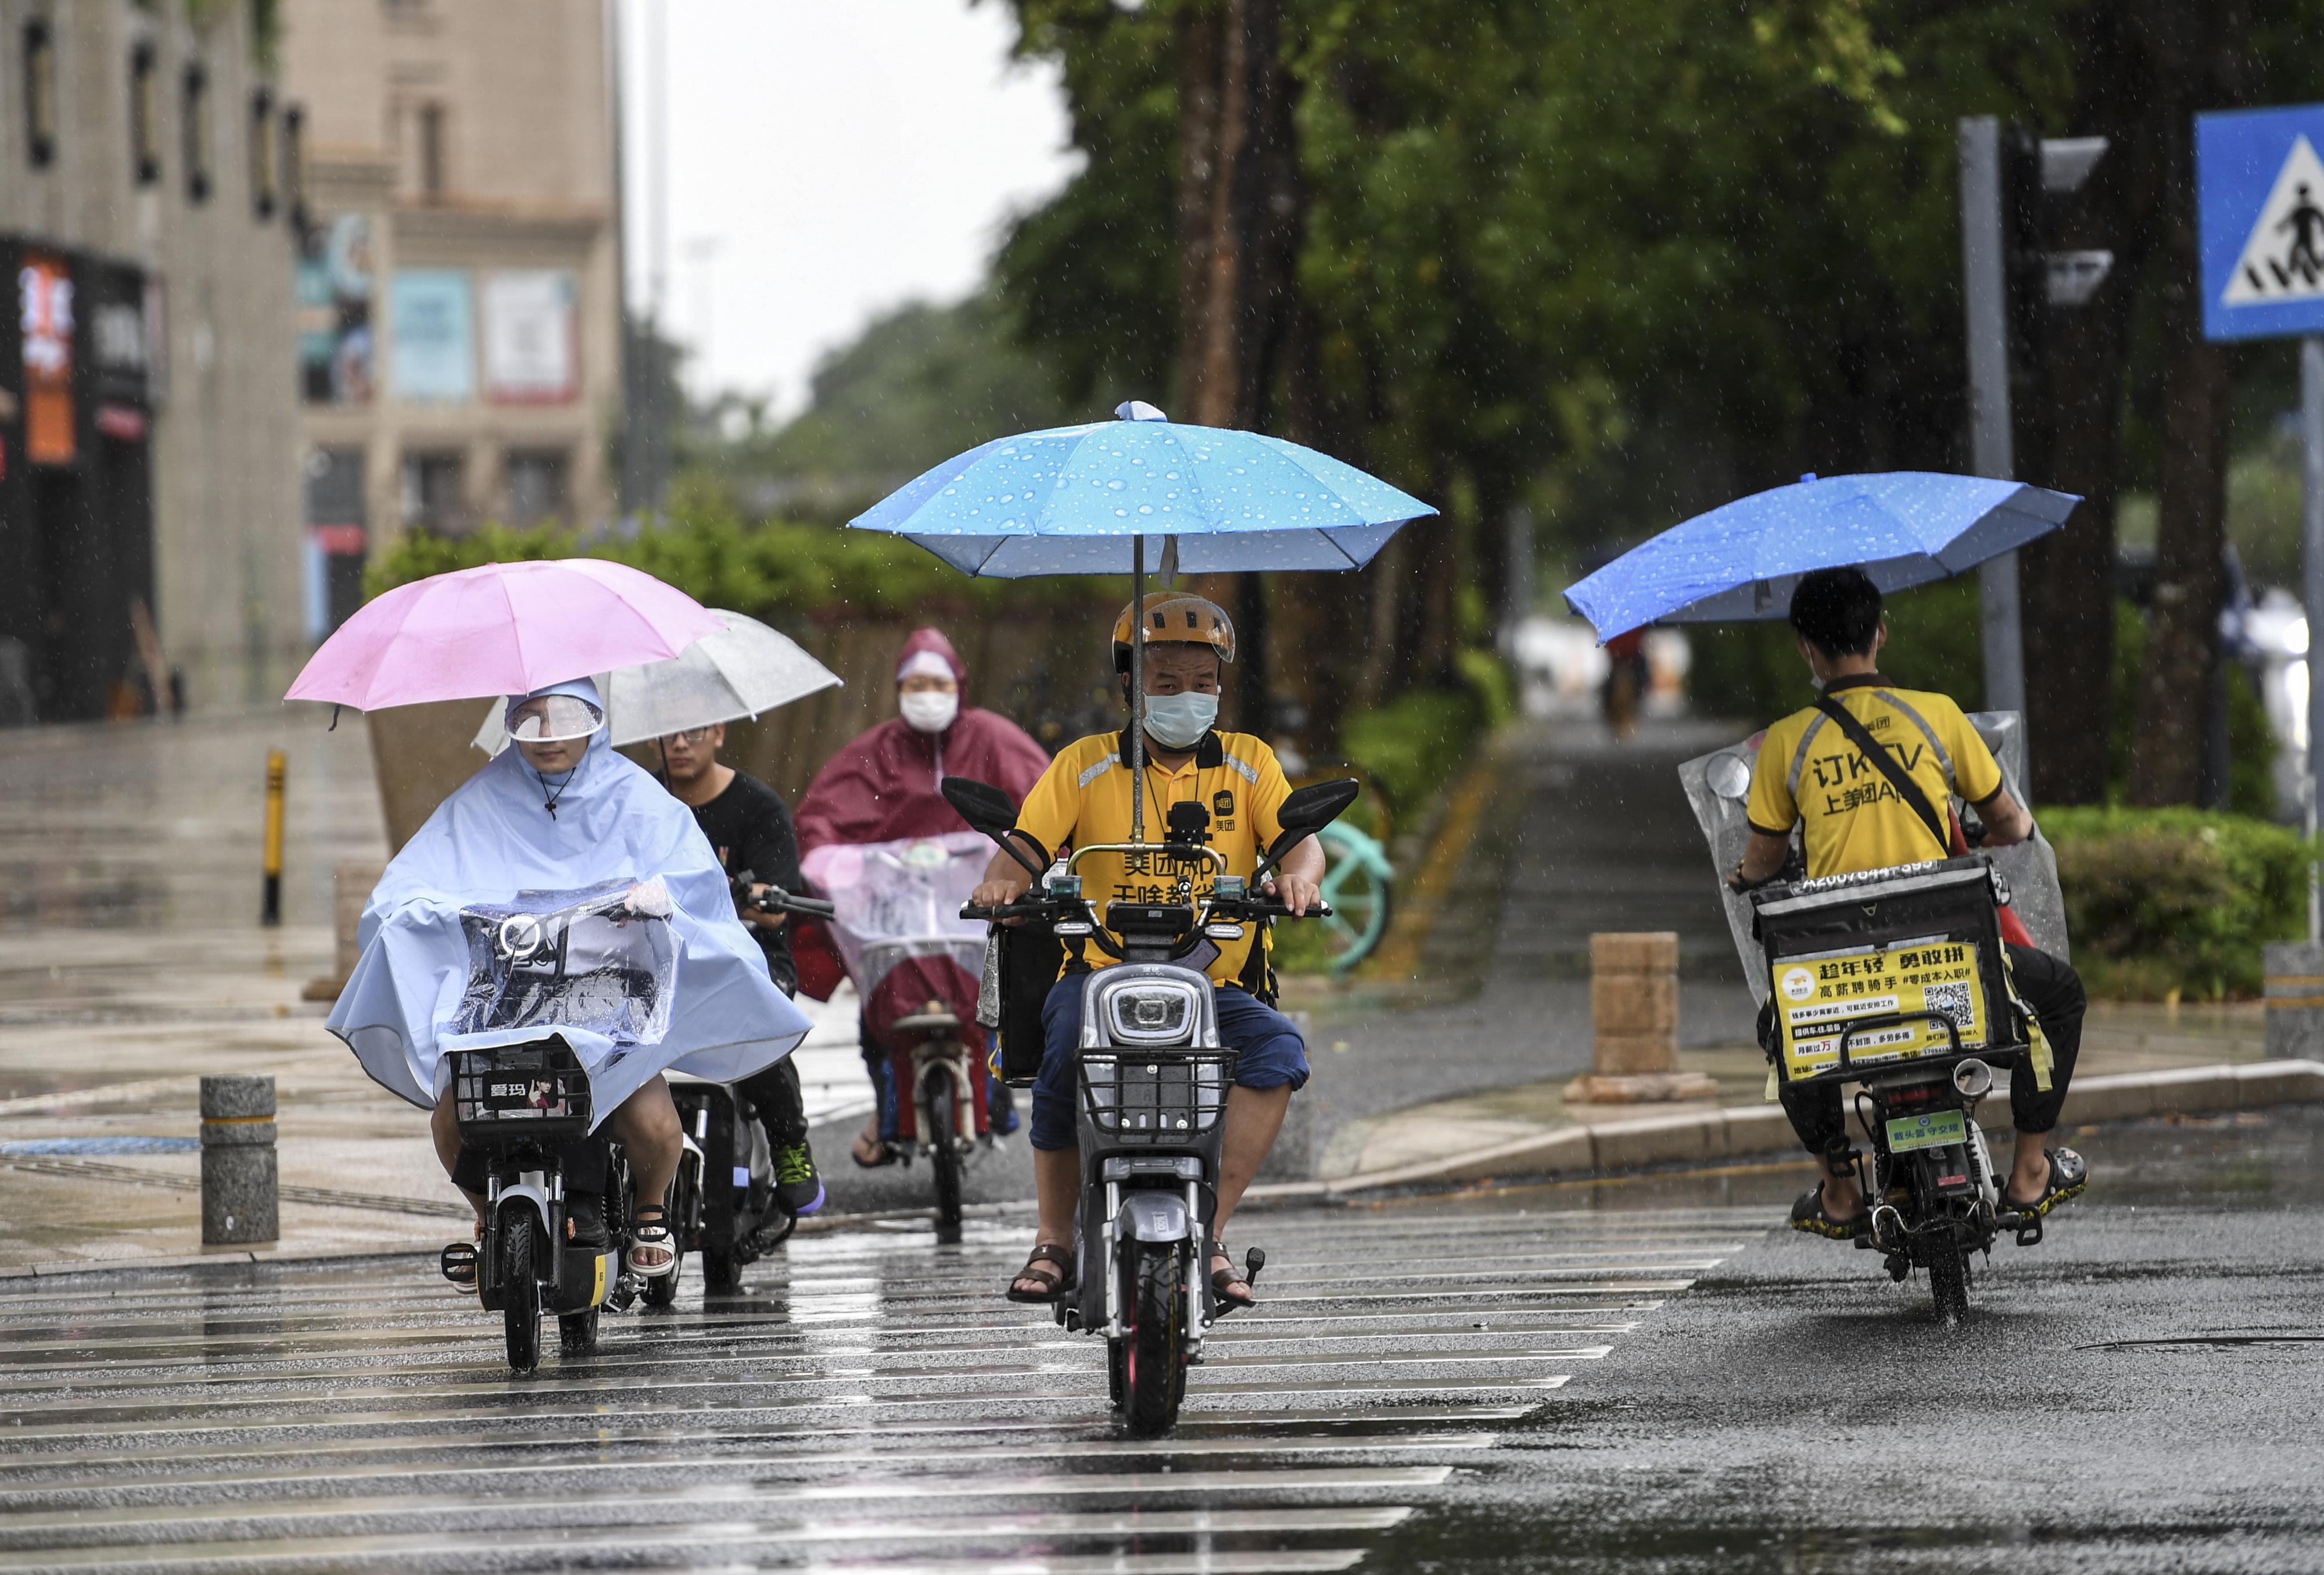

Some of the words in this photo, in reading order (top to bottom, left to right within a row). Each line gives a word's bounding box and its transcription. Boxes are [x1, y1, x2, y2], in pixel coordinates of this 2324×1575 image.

[1216, 798, 1231, 810] 美团
[1216, 819, 1235, 832] 美团
[1819, 957, 1885, 980] 趁年轻
[1899, 946, 1964, 969] 勇敢拼
[1819, 976, 1897, 998] 高薪聘骑手
[1903, 967, 1971, 985] #零成本入职#
[1798, 1032, 1910, 1055] 月薪过万，不封顶，多劳多得
[491, 1083, 526, 1097] 爱玛
